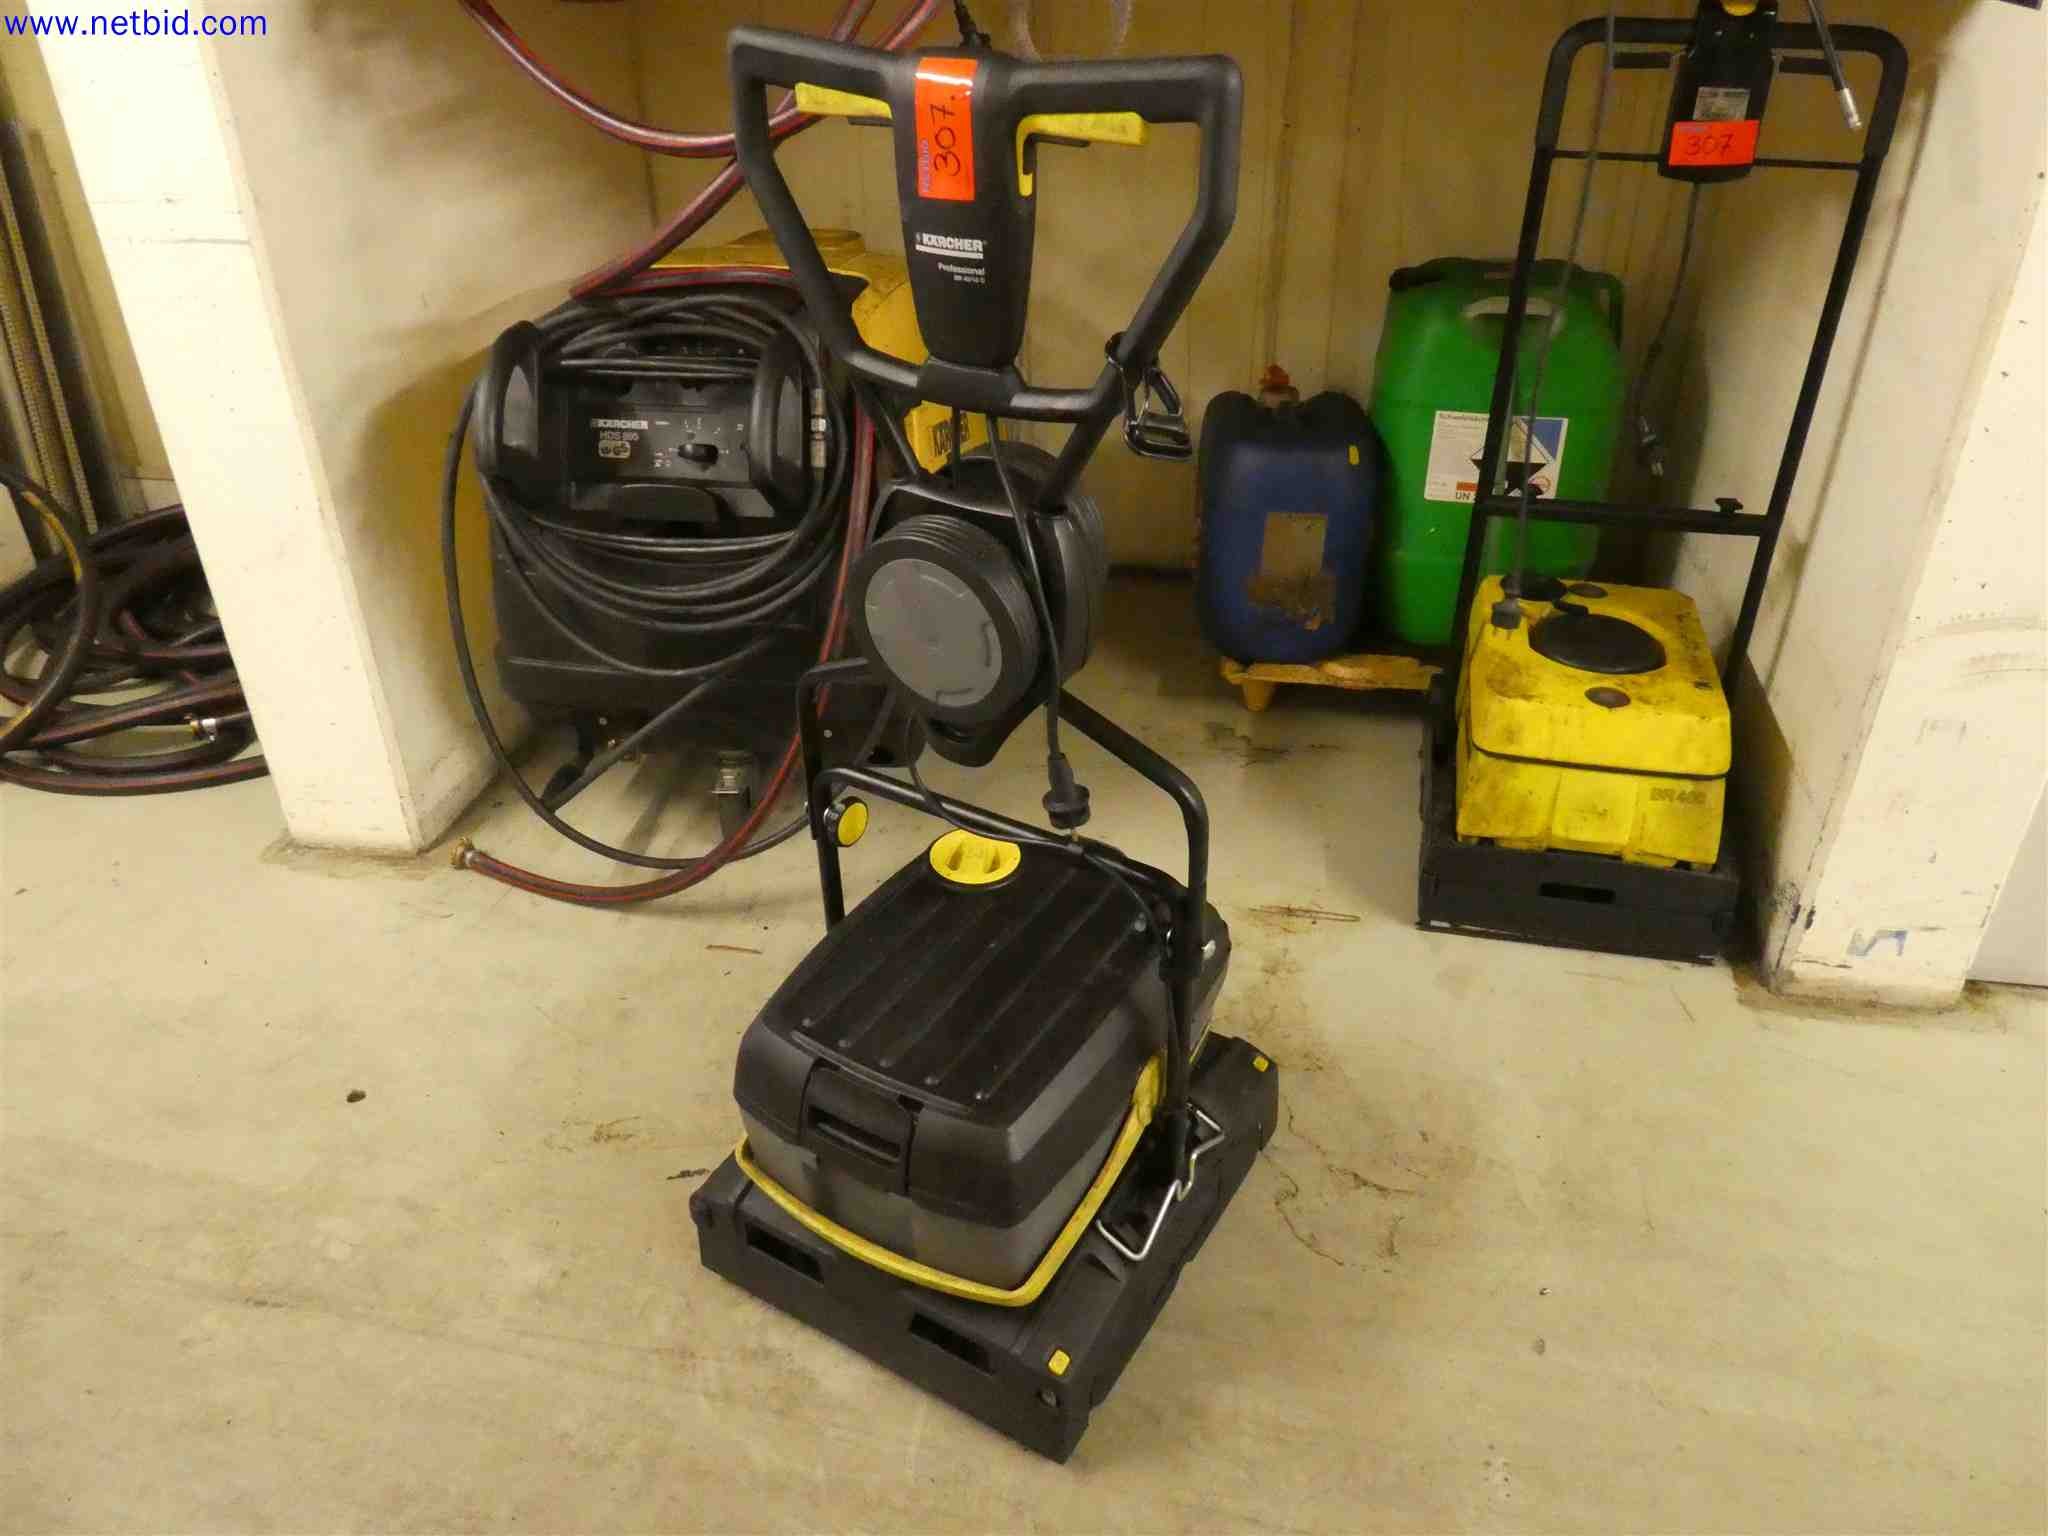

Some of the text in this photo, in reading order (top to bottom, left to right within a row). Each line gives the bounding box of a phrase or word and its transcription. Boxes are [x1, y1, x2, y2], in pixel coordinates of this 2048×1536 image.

[1685, 133, 1735, 158] 307
[938, 262, 985, 275] Professional
[1455, 491, 1471, 501] UN
